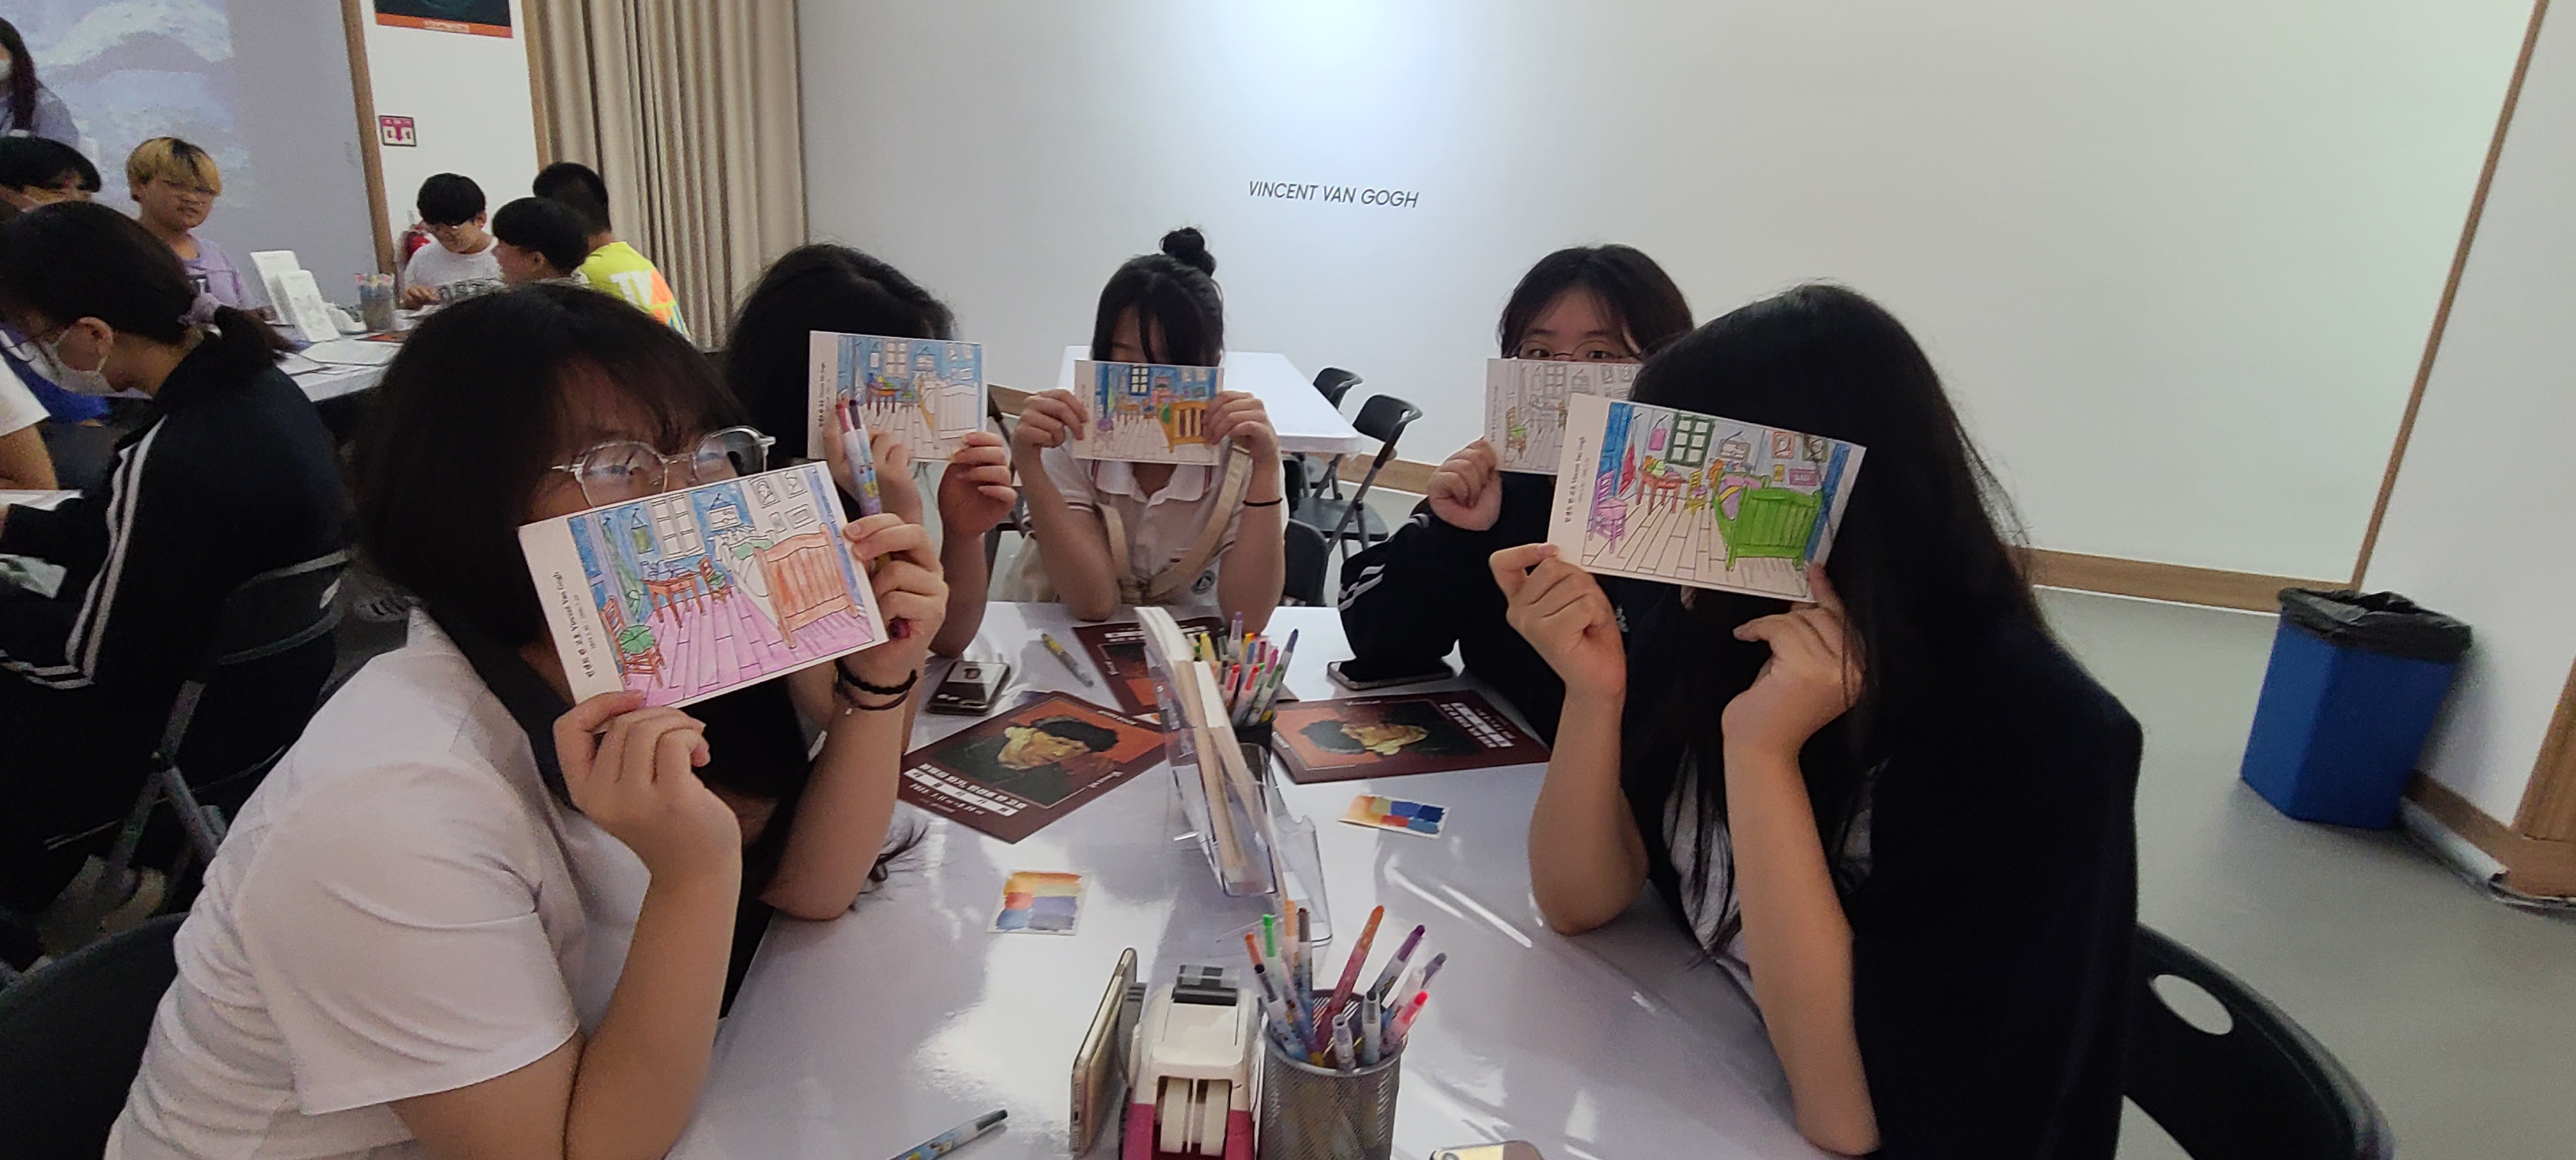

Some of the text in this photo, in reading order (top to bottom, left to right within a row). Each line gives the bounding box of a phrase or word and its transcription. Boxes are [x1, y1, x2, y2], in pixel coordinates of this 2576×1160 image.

[1249, 181, 1419, 208] VINCENT VAN GOGH
